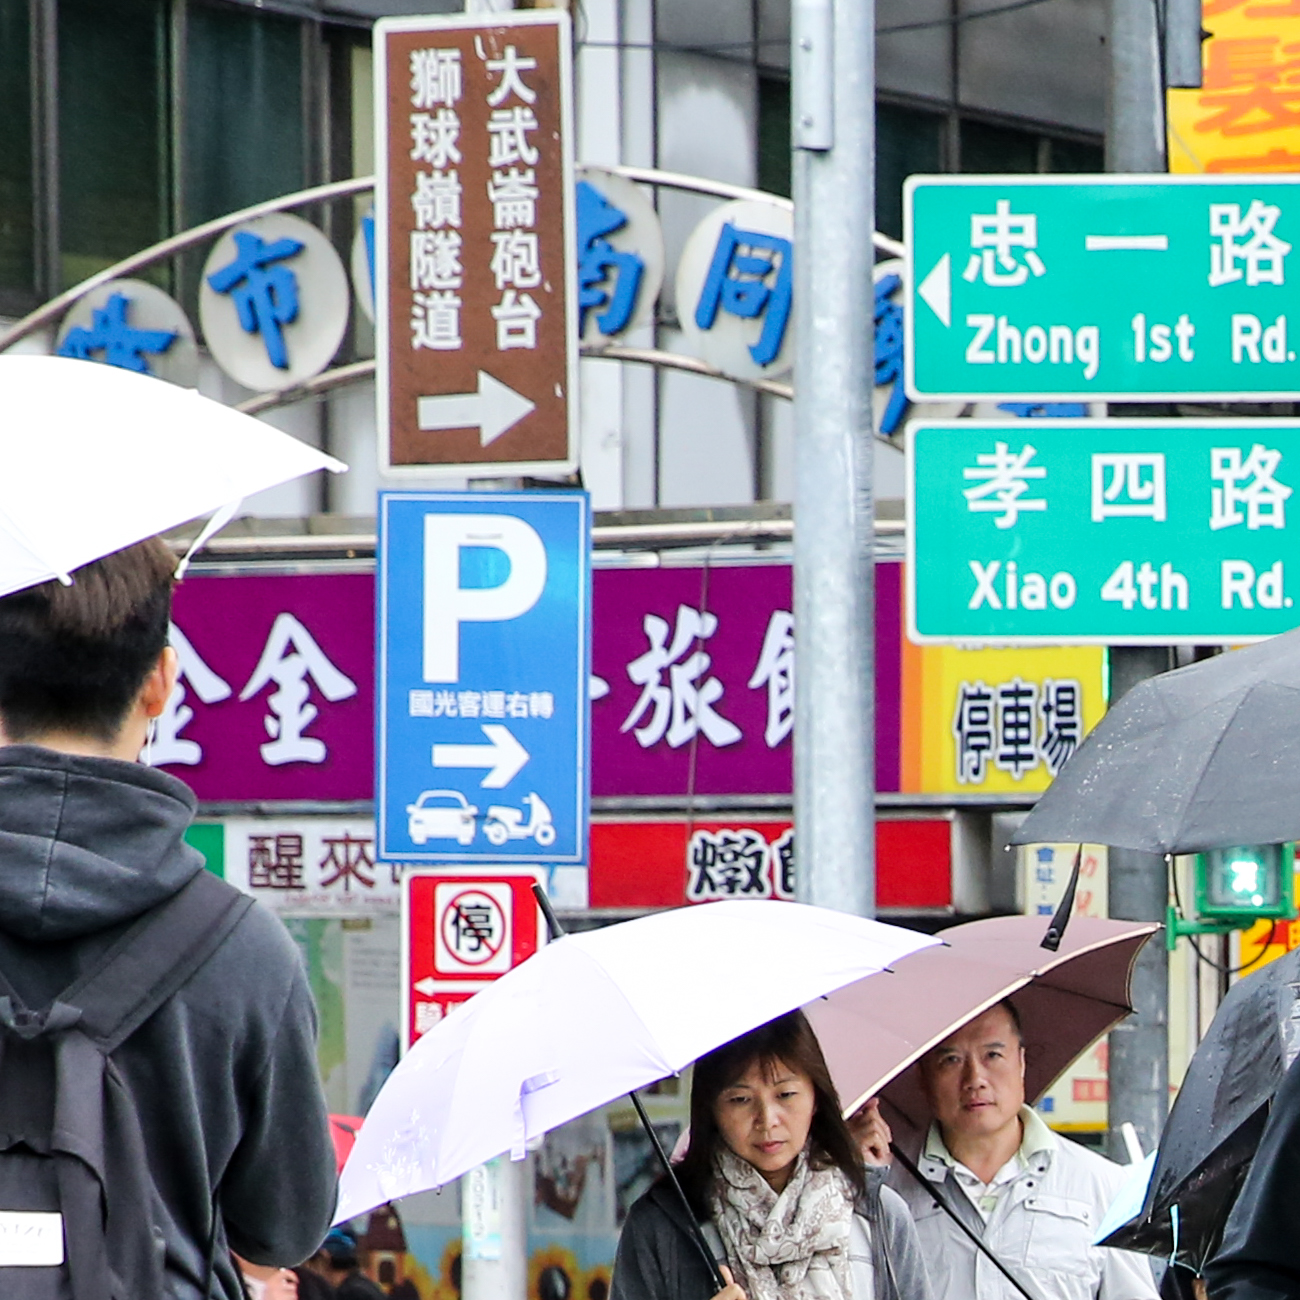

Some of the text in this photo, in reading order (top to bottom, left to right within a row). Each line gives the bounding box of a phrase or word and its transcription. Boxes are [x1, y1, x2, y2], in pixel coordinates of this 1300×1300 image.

[410, 48, 463, 351] 獅球嶺隧道
[486, 44, 542, 351] 大武崙砲台
[962, 199, 1292, 288] 忠一路
[965, 312, 1297, 381] Zhong 1st Rd.
[962, 440, 1293, 531] 孝四路
[423, 513, 548, 683] P
[967, 559, 1294, 611] Xiao 4th Rd.
[408, 689, 554, 720] 國光客運右轉
[955, 677, 1080, 784] 停車場
[451, 904, 493, 952] 停
